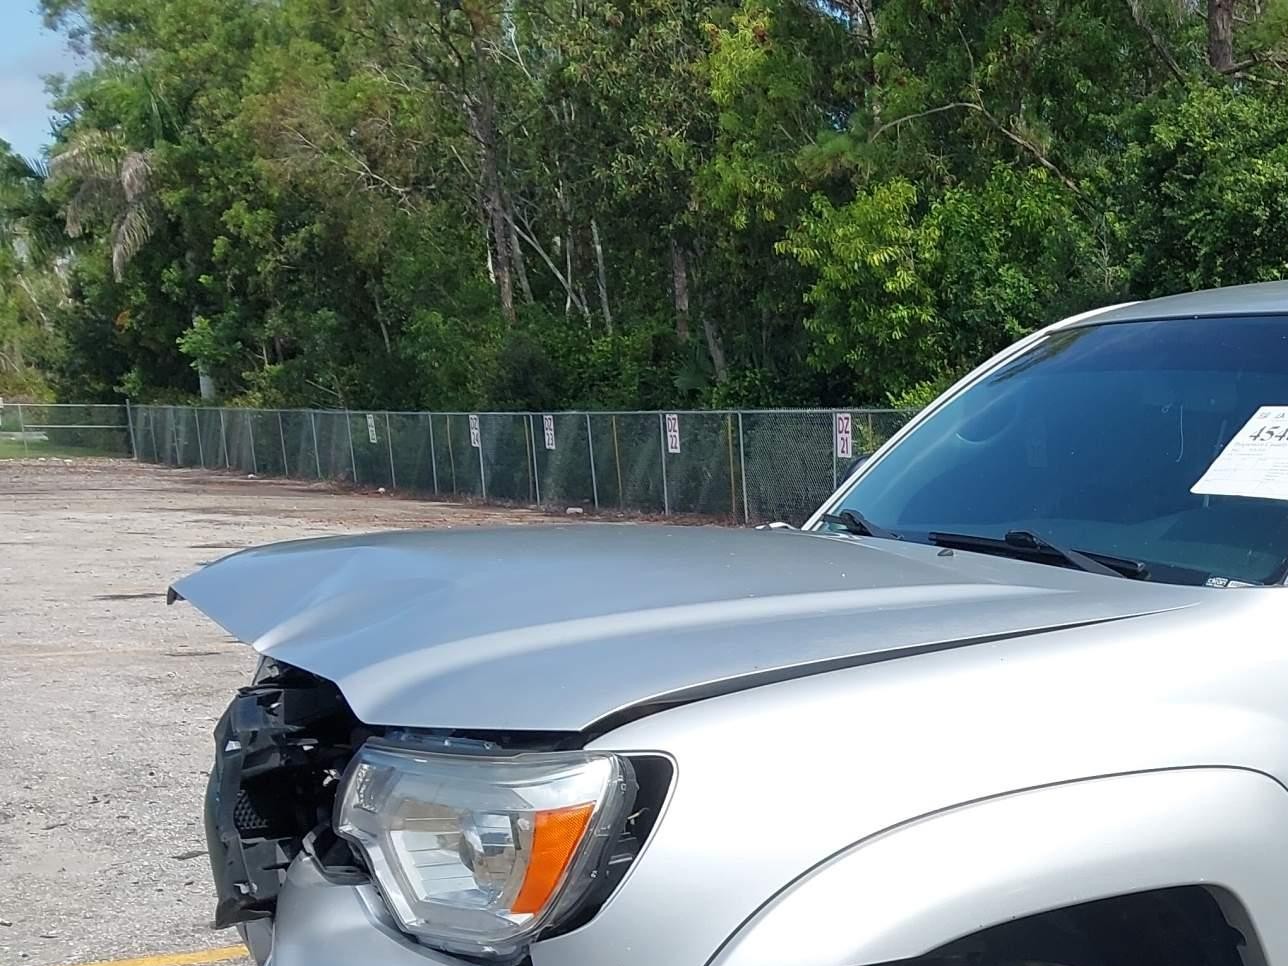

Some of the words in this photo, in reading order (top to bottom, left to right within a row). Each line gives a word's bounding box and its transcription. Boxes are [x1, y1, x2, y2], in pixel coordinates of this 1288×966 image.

[667, 416, 678, 433] DZ
[837, 416, 850, 434] DZ
[669, 434, 679, 450] 22
[840, 437, 849, 454] 21
